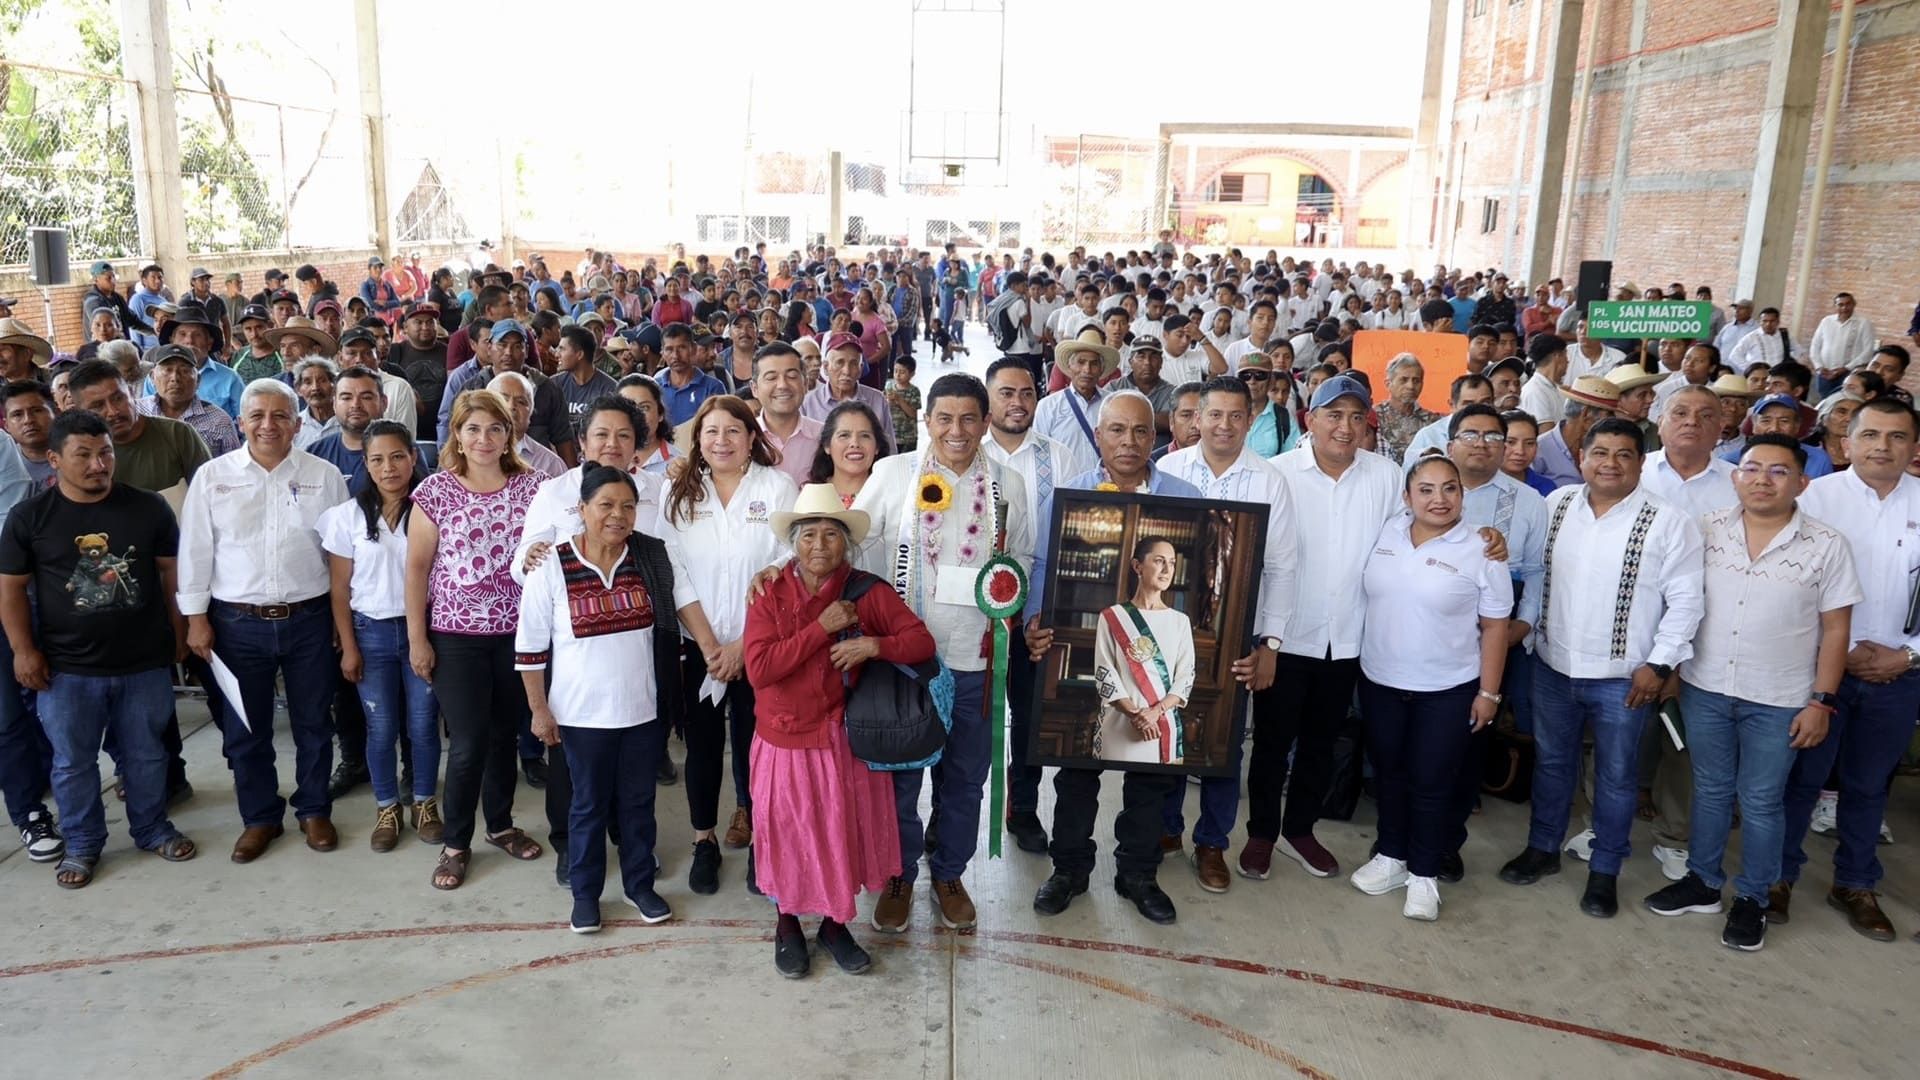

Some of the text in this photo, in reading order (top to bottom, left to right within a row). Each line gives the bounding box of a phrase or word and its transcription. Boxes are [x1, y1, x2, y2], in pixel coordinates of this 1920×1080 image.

[1619, 306, 1645, 318] SAN
[1647, 306, 1697, 318] MATEO
[1591, 320, 1702, 333] 105 YUCUTINDOO
